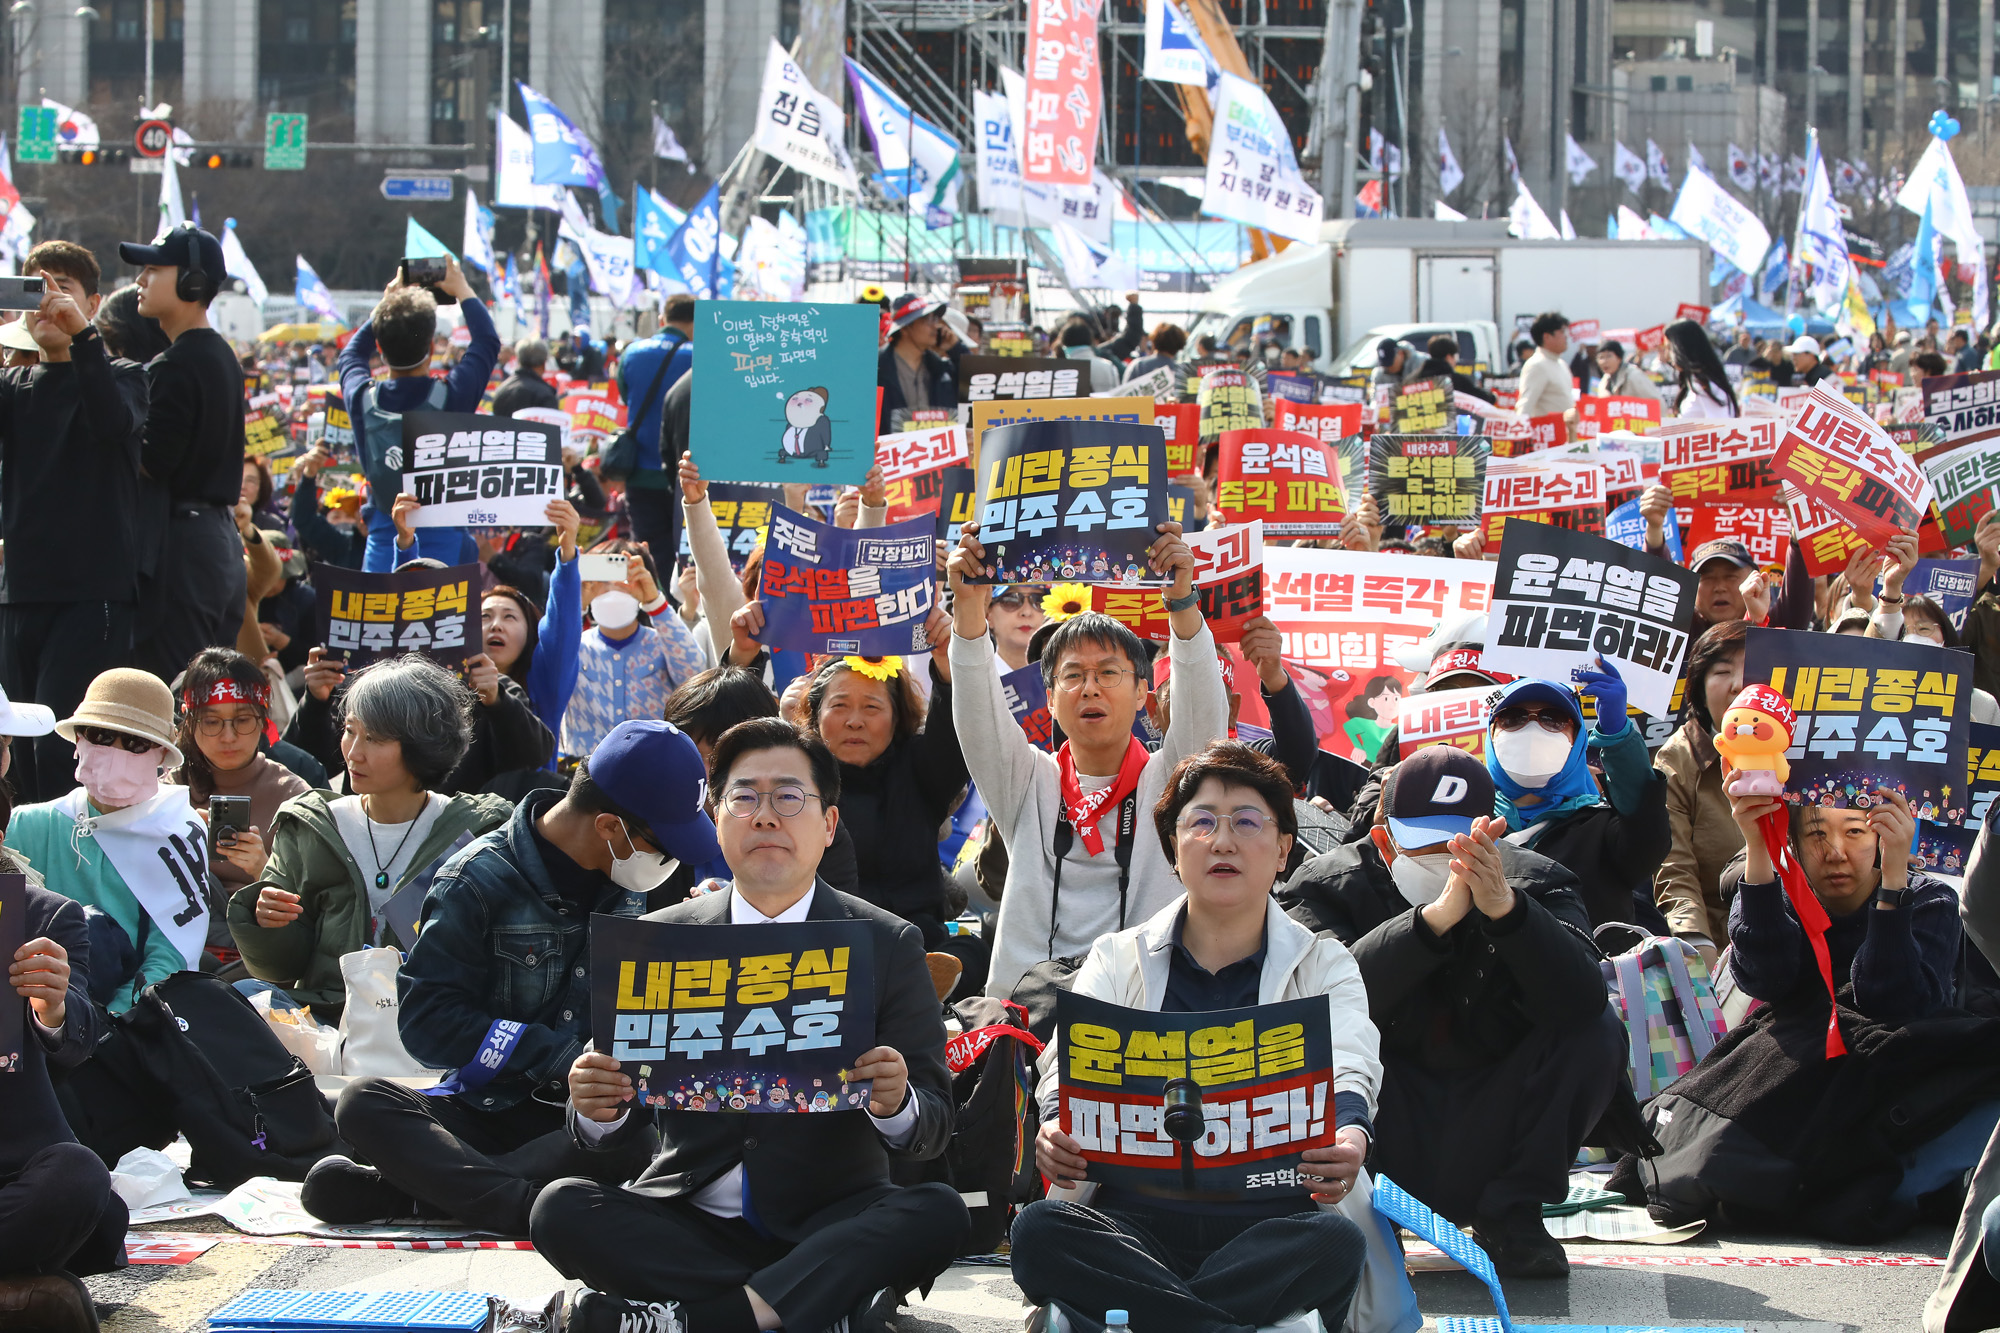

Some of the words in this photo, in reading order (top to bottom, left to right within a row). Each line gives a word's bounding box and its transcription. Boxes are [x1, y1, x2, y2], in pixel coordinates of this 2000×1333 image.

[143, 129, 165, 148] 40
[779, 348, 817, 363] 파면역
[968, 368, 1080, 401] 윤석열을
[413, 431, 549, 469] 윤석열을
[875, 429, 957, 478] 란수괴
[1241, 443, 1329, 478] 윤석열
[1406, 442, 1450, 456] 내란수괴
[1663, 422, 1776, 466] 내란수괴
[1795, 403, 1925, 504] 내란수괴
[985, 449, 1066, 501] 내란
[1068, 445, 1149, 488] 종식
[1387, 456, 1476, 478] 윤석열을
[413, 468, 560, 507] 파면하라!
[1219, 480, 1279, 513] 즉각
[1286, 480, 1347, 514] 파면
[1388, 494, 1477, 516] 파면하라
[1484, 469, 1598, 508] 내란수괴
[467, 513, 498, 524] 민주당
[978, 494, 1059, 545] 민주
[1063, 486, 1149, 533] 수호
[1946, 487, 1994, 534] 박살
[868, 545, 926, 562] 만장일치
[763, 560, 882, 600] 윤석열을
[1362, 575, 1449, 618] 즉각
[1508, 552, 1682, 623] 윤석열을
[1937, 575, 1973, 592] 만장일치
[330, 592, 399, 623] 내란
[400, 580, 469, 621] 종식
[808, 577, 936, 634] 파면한다
[328, 620, 396, 654] 민주
[398, 615, 466, 652] 수호
[1497, 603, 1686, 674] 파면하라!
[1769, 665, 1870, 714] 내란
[1870, 668, 1959, 718] 종식
[1403, 699, 1489, 736] 내란
[1862, 716, 1952, 765] 수호
[1429, 775, 1469, 805] D
[1122, 798, 1135, 836] Canon
[615, 954, 733, 1011] 내란
[736, 945, 851, 1006] 종식
[611, 1010, 725, 1063] 민주
[731, 999, 844, 1057] 수호
[1068, 1018, 1306, 1088] 윤석열을
